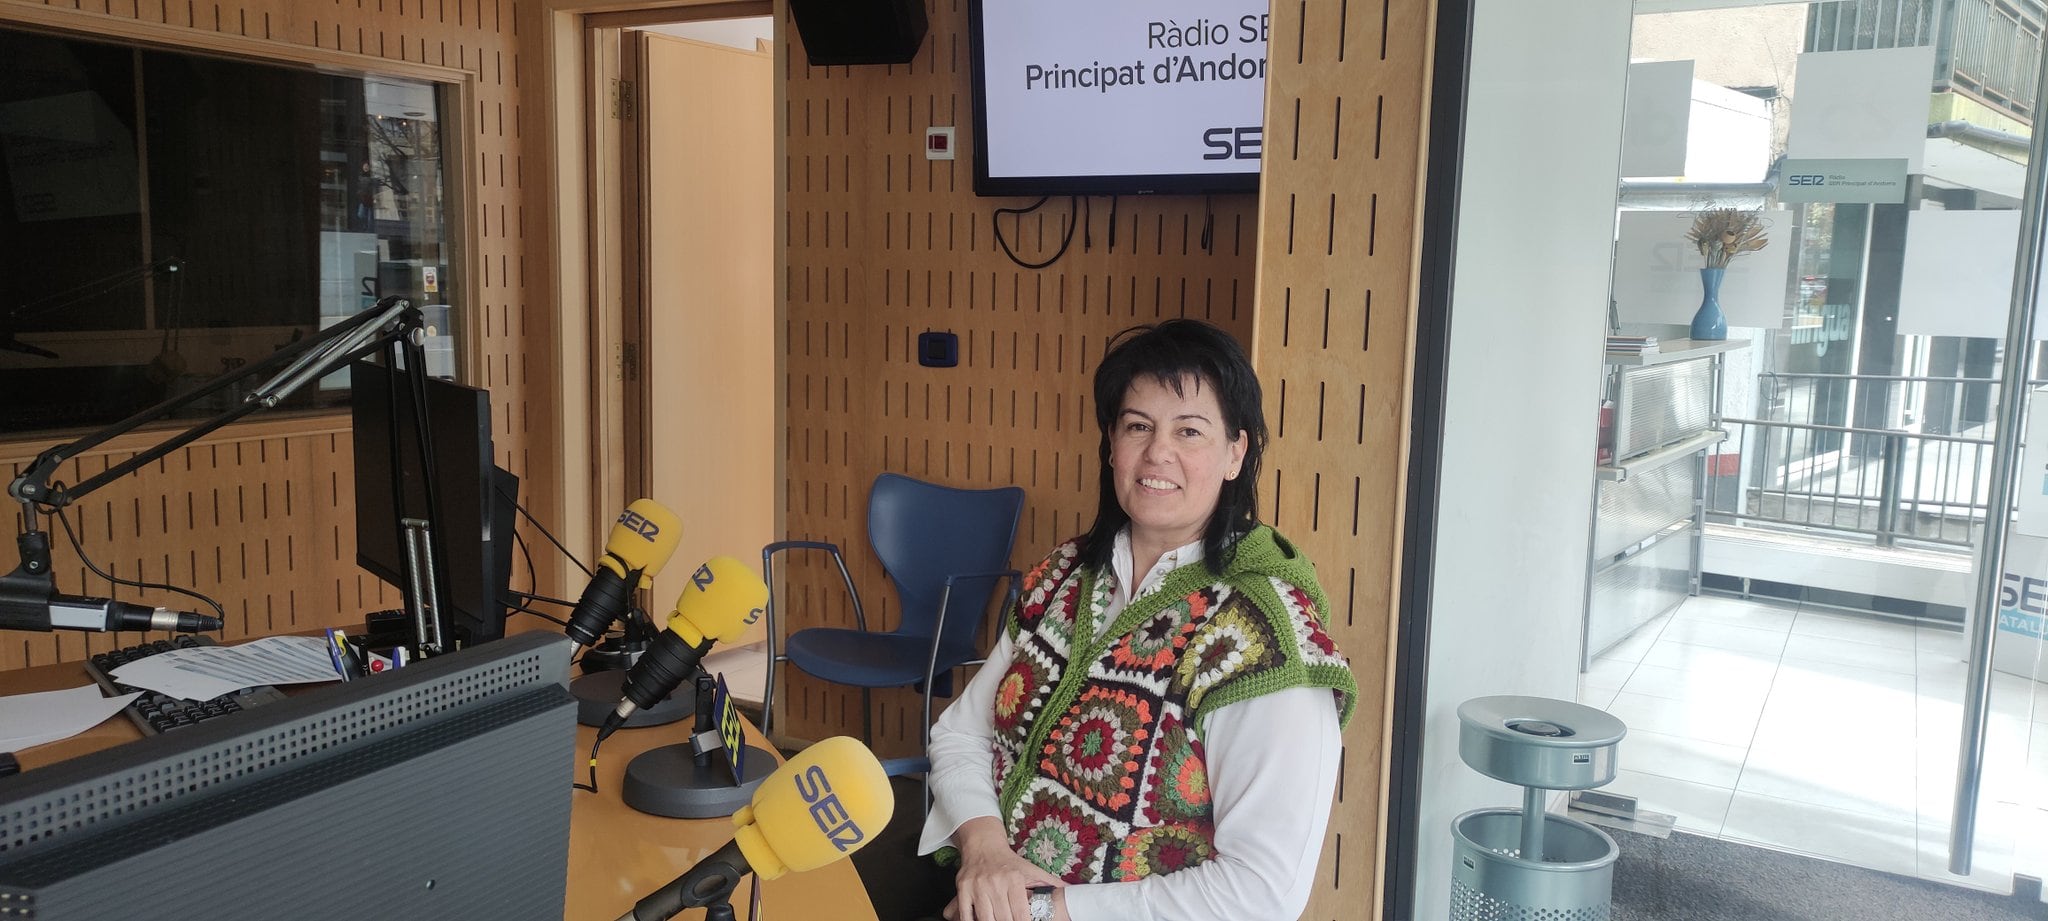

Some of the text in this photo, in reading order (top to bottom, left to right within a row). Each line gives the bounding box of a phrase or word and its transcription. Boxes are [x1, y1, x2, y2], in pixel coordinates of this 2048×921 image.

[1149, 19, 1229, 49] Ràdio
[1026, 60, 1145, 93] Principat
[1789, 175, 1825, 186] SER
[617, 509, 660, 543] SER
[795, 765, 864, 852] SER
